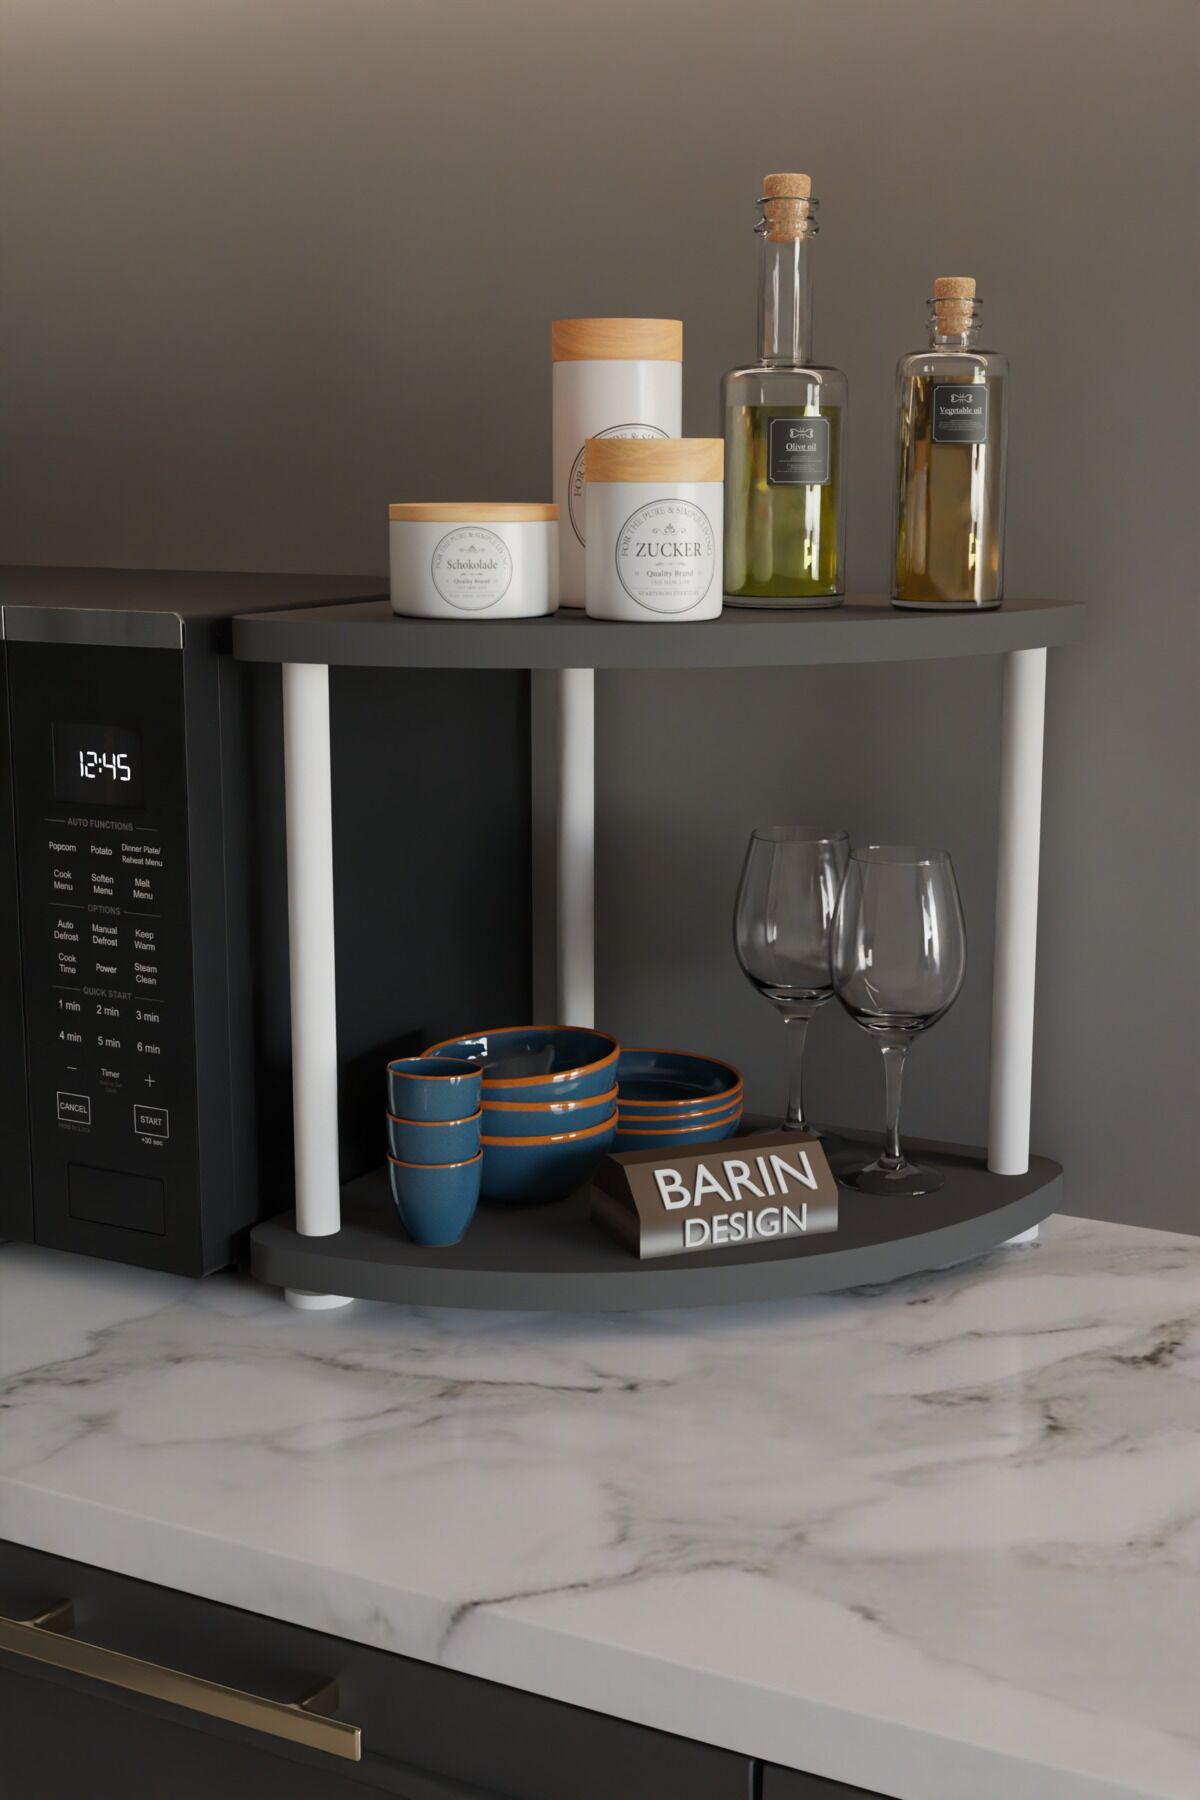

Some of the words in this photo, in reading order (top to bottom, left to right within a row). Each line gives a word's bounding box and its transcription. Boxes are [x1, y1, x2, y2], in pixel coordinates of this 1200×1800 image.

[940, 407, 972, 416] Vegetable
[973, 407, 982, 415] oil
[785, 443, 806, 452] Olive
[807, 443, 817, 452] oil
[573, 471, 585, 497] FOR
[621, 535, 633, 557] FOR
[635, 542, 702, 558] ZUCKER
[446, 559, 499, 570] Schokolade
[646, 570, 672, 578] Quality
[79, 751, 131, 781] 12:45
[67, 817, 89, 828] AUTO
[89, 820, 134, 832] FUNCTIONS
[48, 841, 77, 853] Popcorn
[90, 845, 113, 856] Potato
[121, 843, 142, 854] Dinner
[121, 855, 144, 866] Reheat
[144, 858, 164, 867] Menu
[53, 869, 72, 880] Cook
[91, 873, 114, 884] Soften
[53, 881, 73, 891] Menu
[134, 878, 151, 888] Melt
[93, 885, 114, 896] Menu
[133, 889, 154, 900] Menu
[87, 904, 121, 916] OPTIONS
[57, 920, 74, 930] Auto
[91, 923, 118, 935] Manual
[53, 930, 79, 942] Defrost
[92, 935, 118, 947] Defrost
[135, 929, 155, 941] Keep
[134, 940, 156, 951] Warm
[58, 952, 77, 963] Cook
[59, 963, 77, 974] Time
[95, 963, 118, 974] Power
[134, 962, 158, 974] Steam
[135, 974, 157, 985] Clean
[82, 986, 107, 998] QUICK
[107, 990, 132, 1001] START
[58, 1000, 63, 1009] 1
[65, 1001, 81, 1012] min
[96, 1004, 103, 1015] 2
[104, 1006, 120, 1017] min
[135, 1010, 142, 1021] 3
[143, 1012, 160, 1023] min
[59, 1030, 65, 1040] 4
[66, 1032, 82, 1043] min
[97, 1036, 104, 1046] 5
[105, 1038, 121, 1049] min
[136, 1042, 143, 1052] 6
[145, 1044, 161, 1055] min
[101, 1068, 120, 1079] Timer
[59, 1101, 88, 1114] CANCEL
[140, 1115, 163, 1126] START
[653, 1150, 819, 1211] BARIN
[684, 1202, 808, 1249] DESIGN
